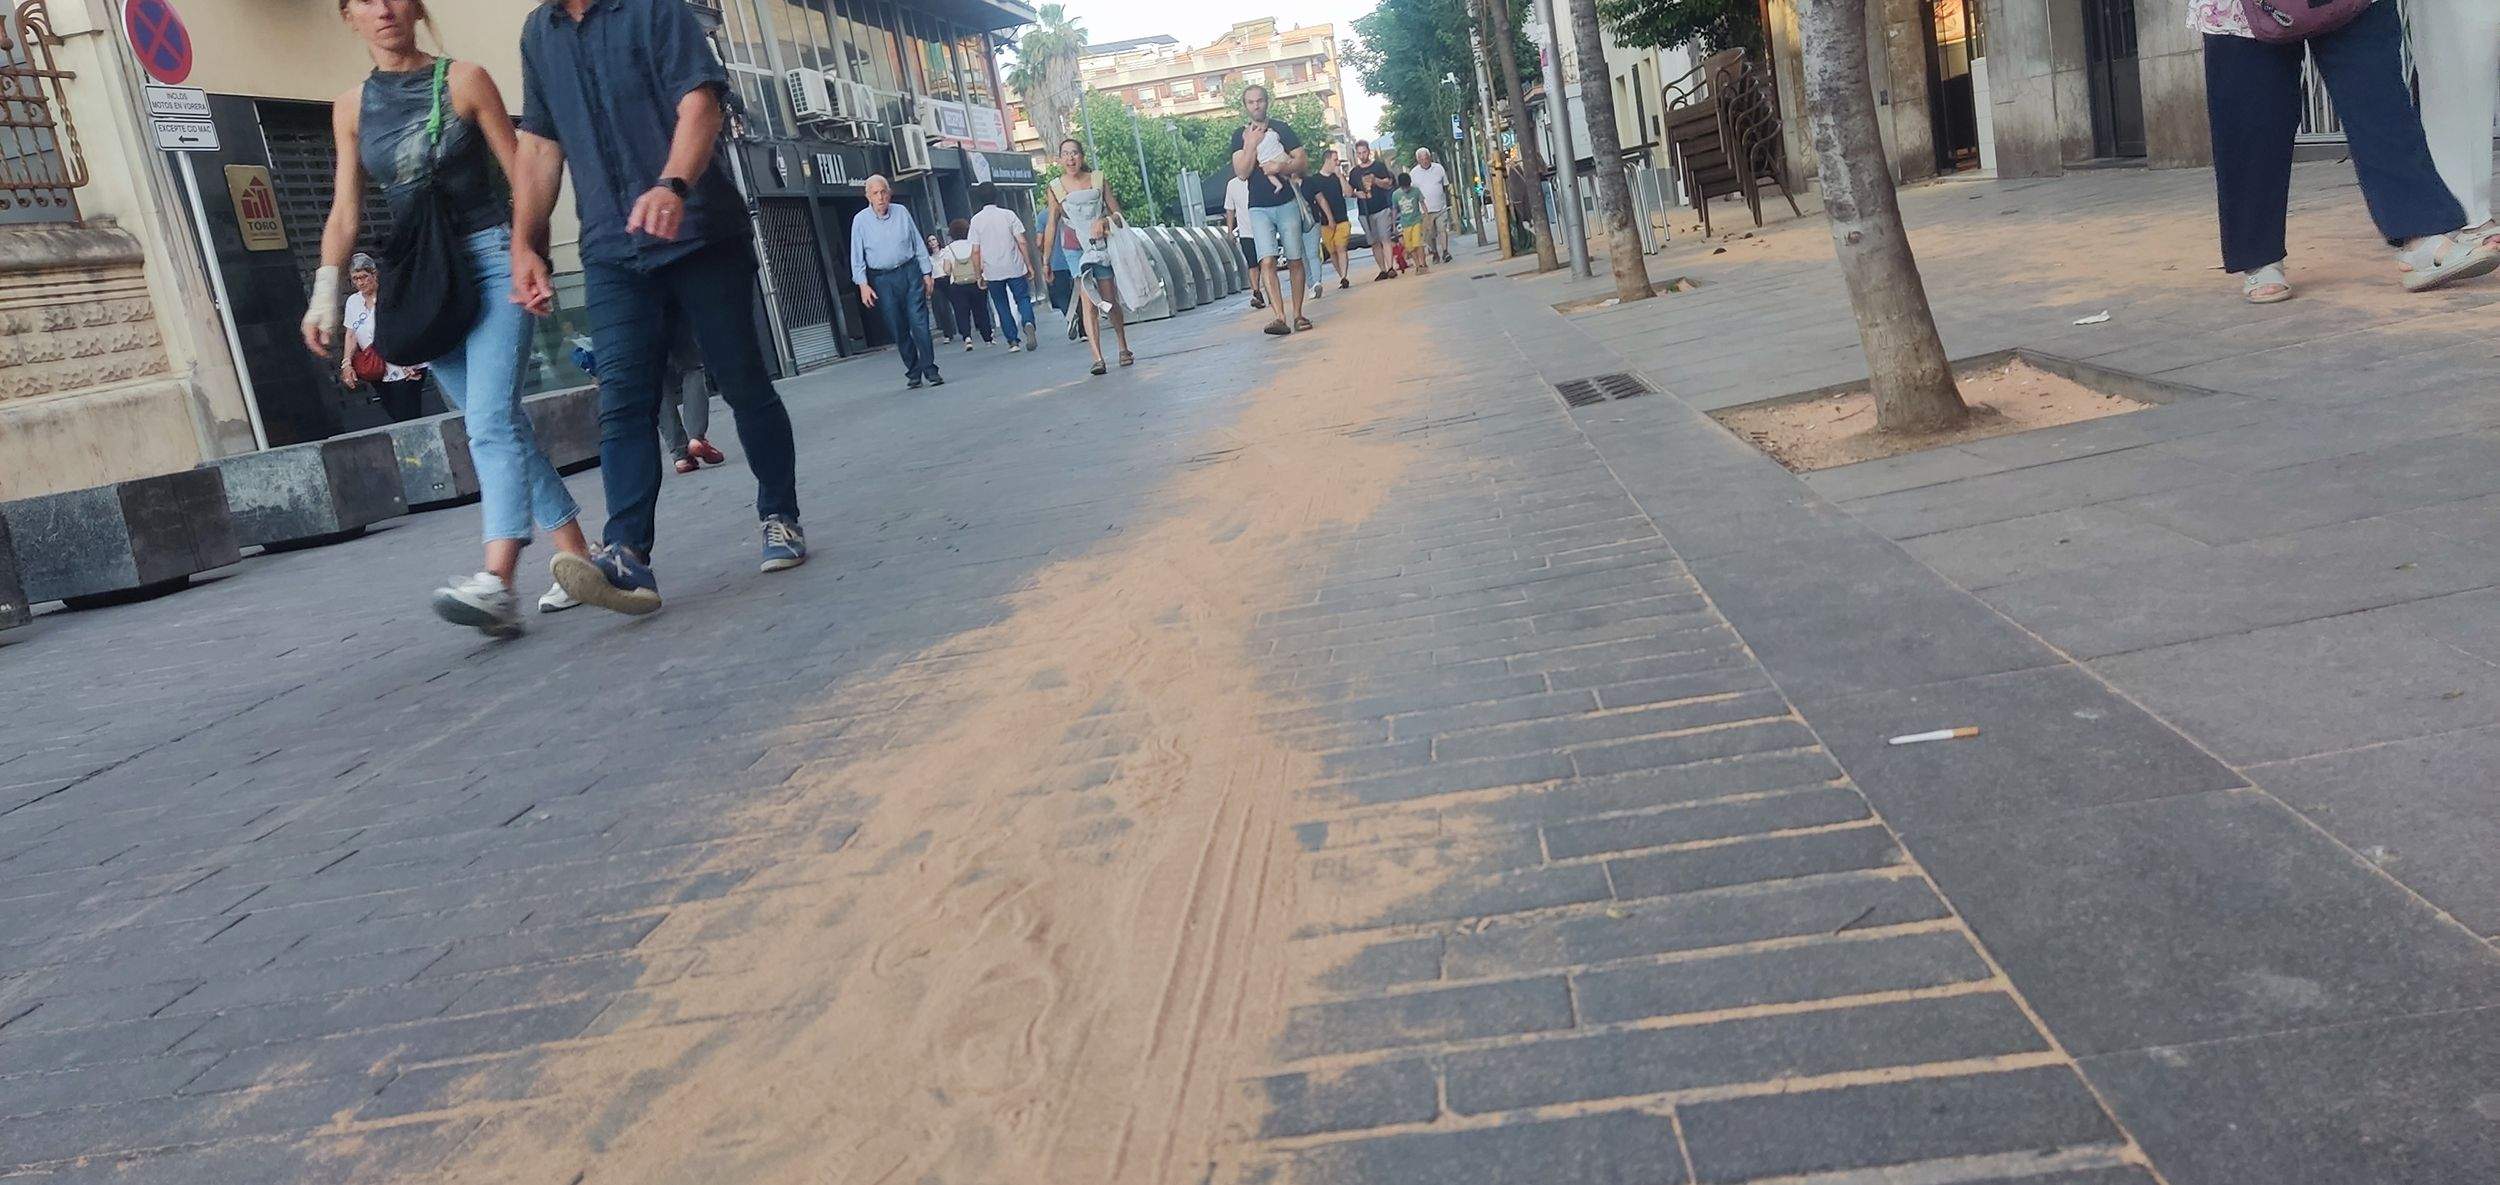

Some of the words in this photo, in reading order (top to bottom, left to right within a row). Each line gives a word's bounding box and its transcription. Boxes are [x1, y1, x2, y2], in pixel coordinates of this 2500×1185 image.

[152, 101, 173, 110] MOTOS
[184, 103, 207, 111] VORERA
[158, 125, 187, 133] EXCEPTE
[247, 221, 278, 231] TORO
